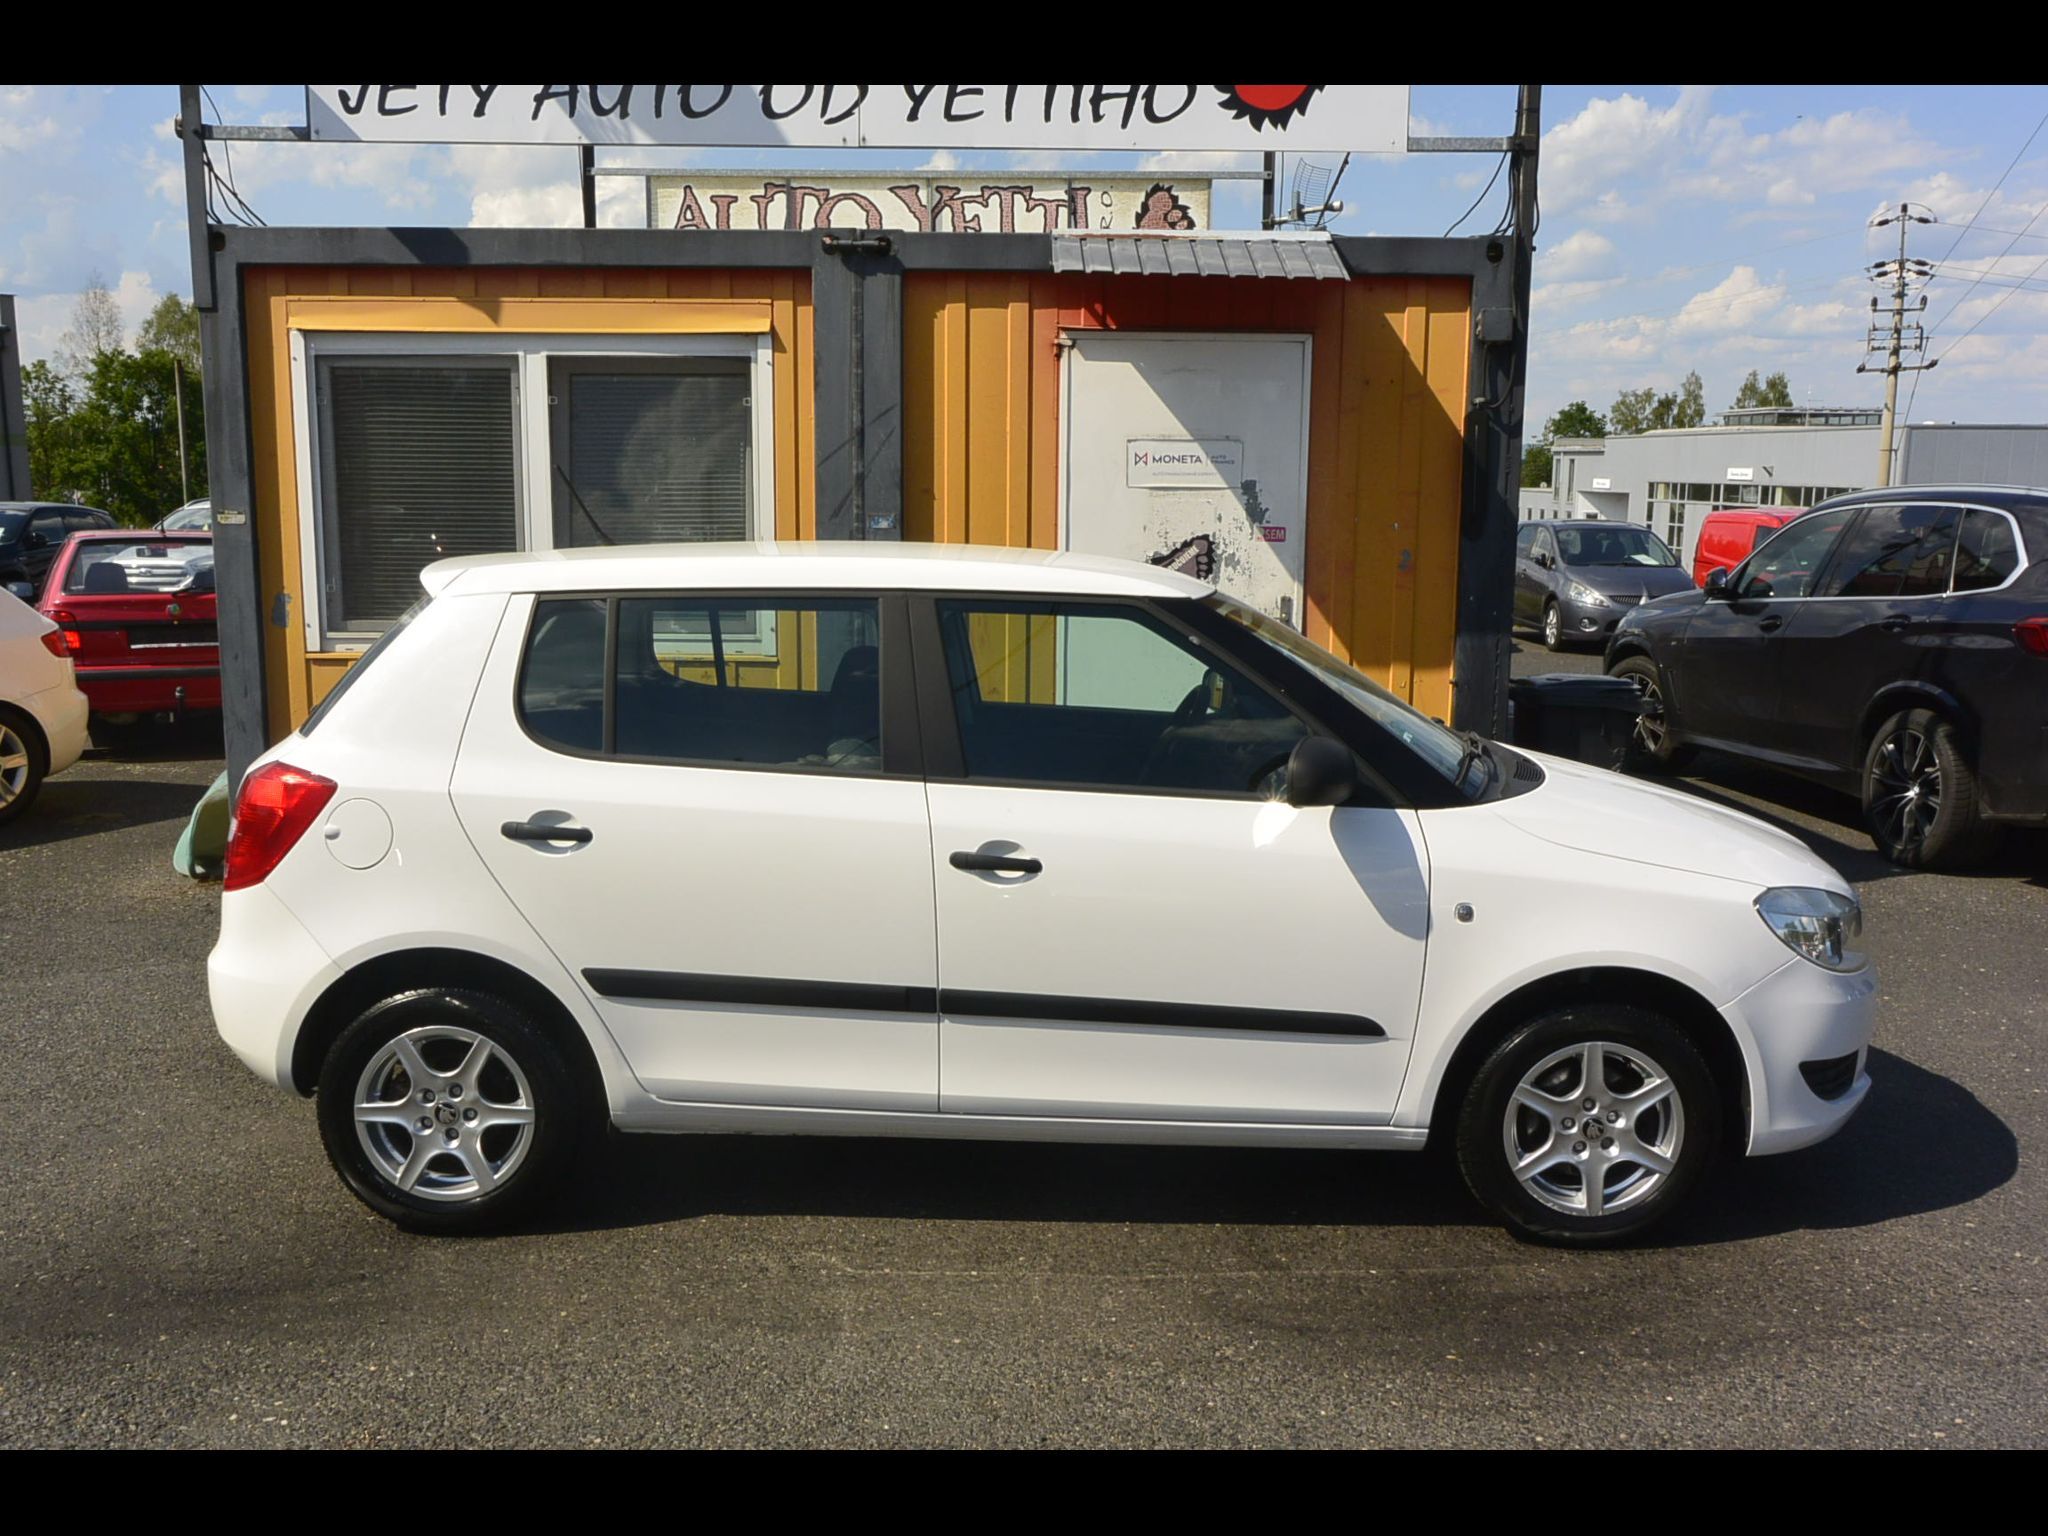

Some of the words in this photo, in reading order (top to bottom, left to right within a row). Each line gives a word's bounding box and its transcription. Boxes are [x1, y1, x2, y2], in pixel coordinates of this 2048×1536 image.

[532, 85, 733, 120] AUTO
[759, 85, 869, 125] OD
[1152, 454, 1203, 464] MONETA
[1265, 529, 1285, 540] SEM
